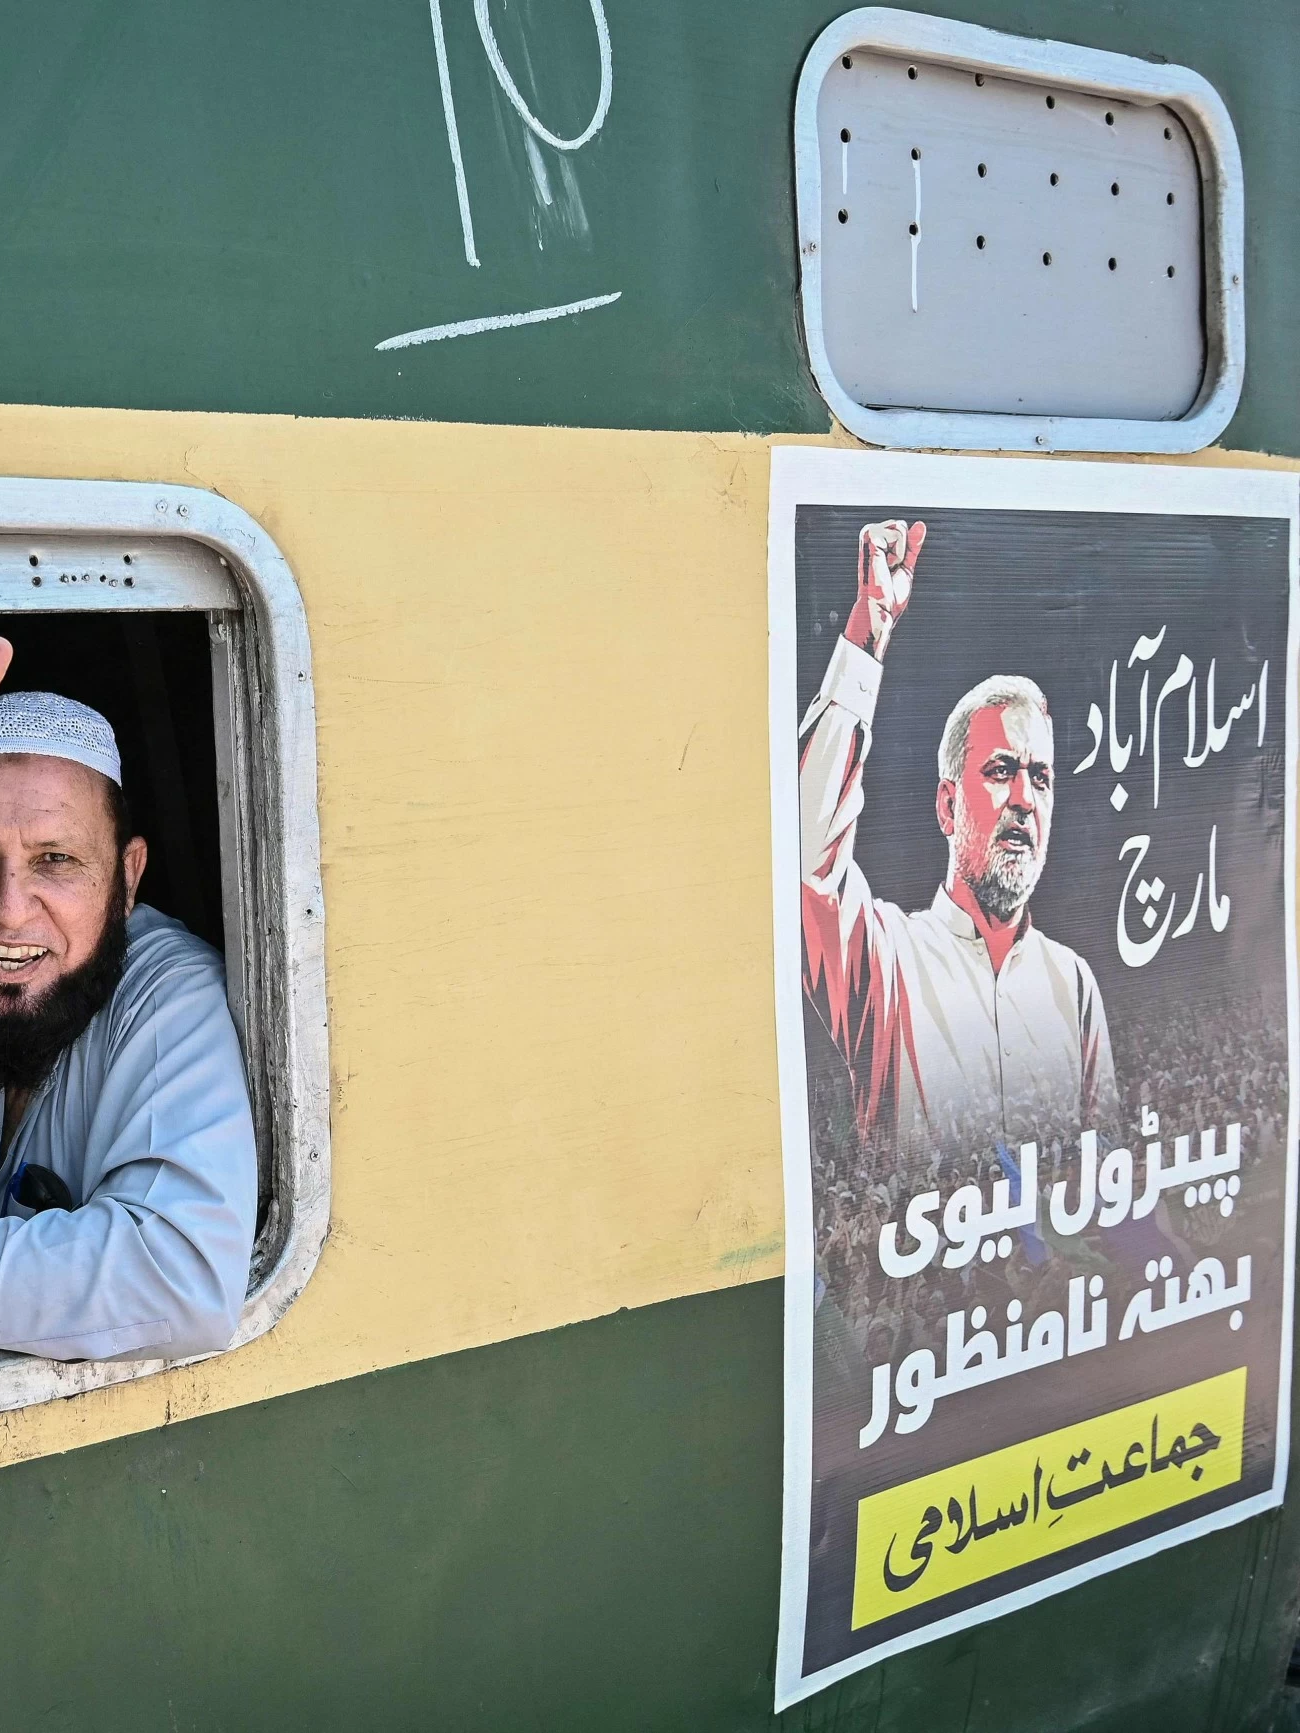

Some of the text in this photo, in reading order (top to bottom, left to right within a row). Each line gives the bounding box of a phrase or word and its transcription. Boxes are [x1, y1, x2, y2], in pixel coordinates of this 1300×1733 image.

[1072, 624, 1270, 813] اسلام آباد
[1116, 824, 1231, 968] مارچ
[878, 1105, 1242, 1278] پیٹرول لیوی
[1118, 1254, 1252, 1341] بھتہ
[883, 1456, 1043, 1593] اسلامی
